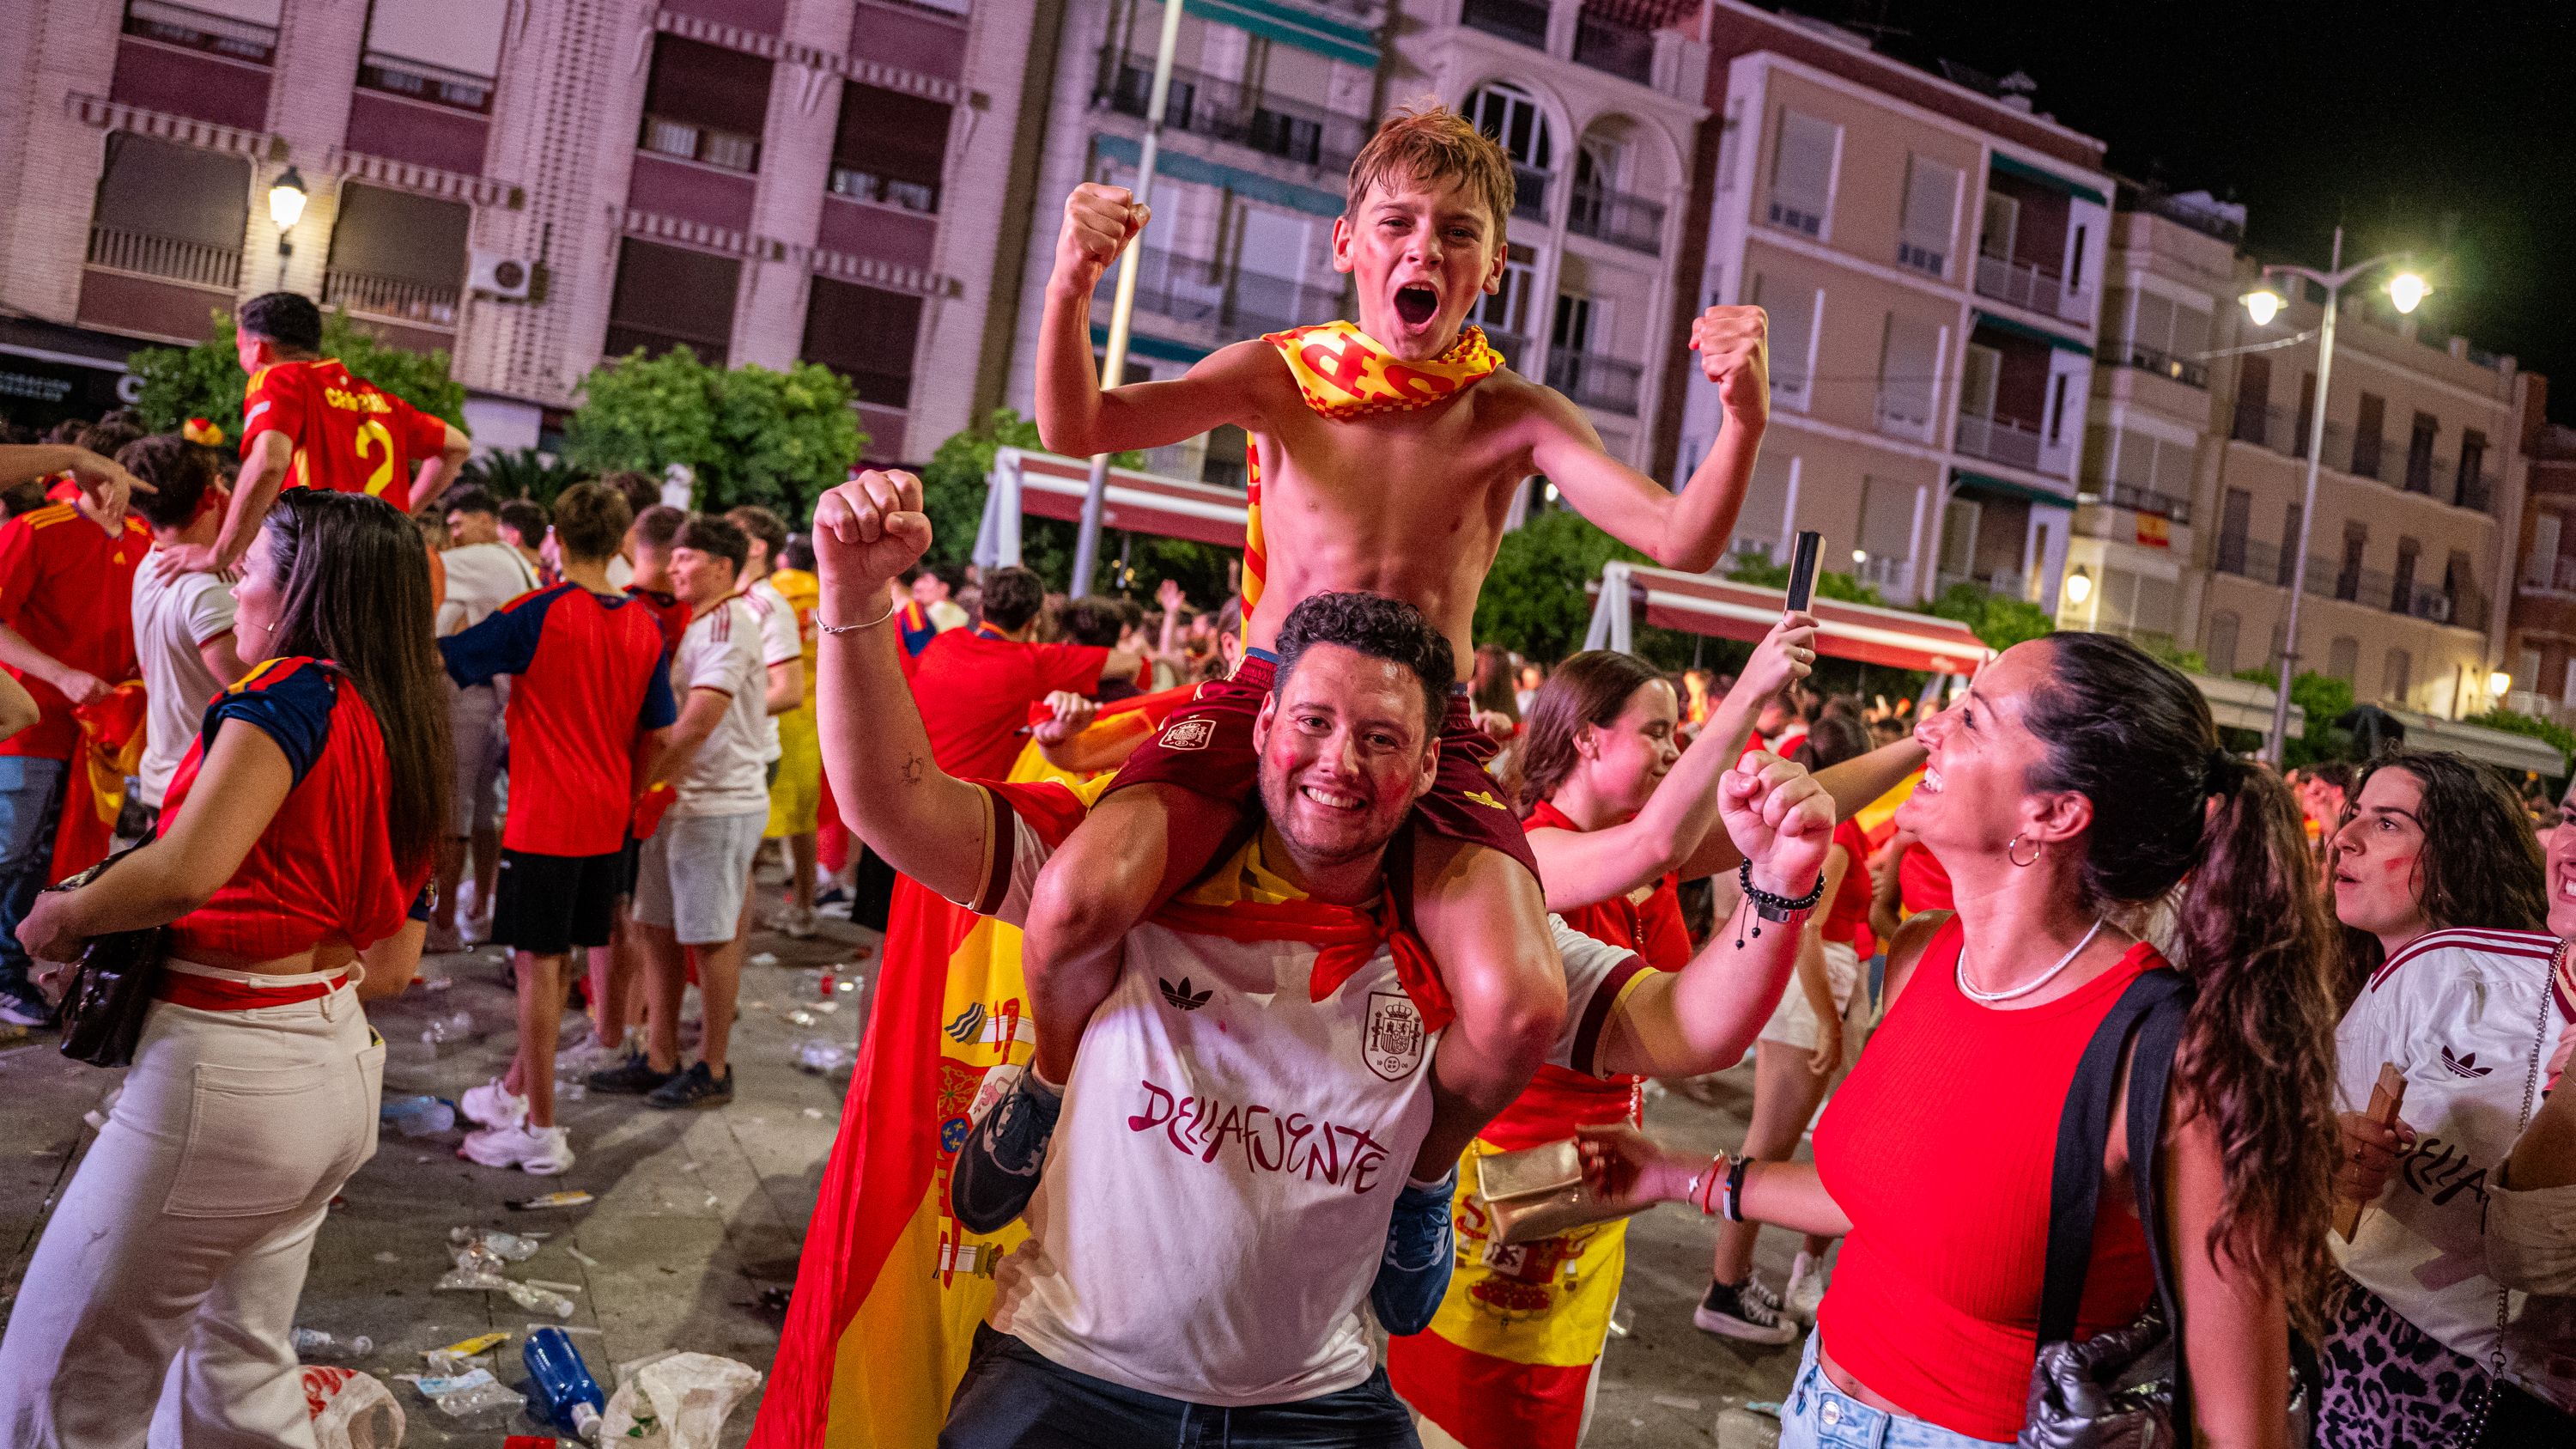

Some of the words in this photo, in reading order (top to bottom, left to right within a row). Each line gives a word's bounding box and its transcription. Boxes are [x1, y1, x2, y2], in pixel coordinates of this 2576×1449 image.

[355, 419, 394, 496] 2
[1127, 1080, 1390, 1195] DELLAFUENTE
[2394, 1138, 2491, 1236] ELLA
